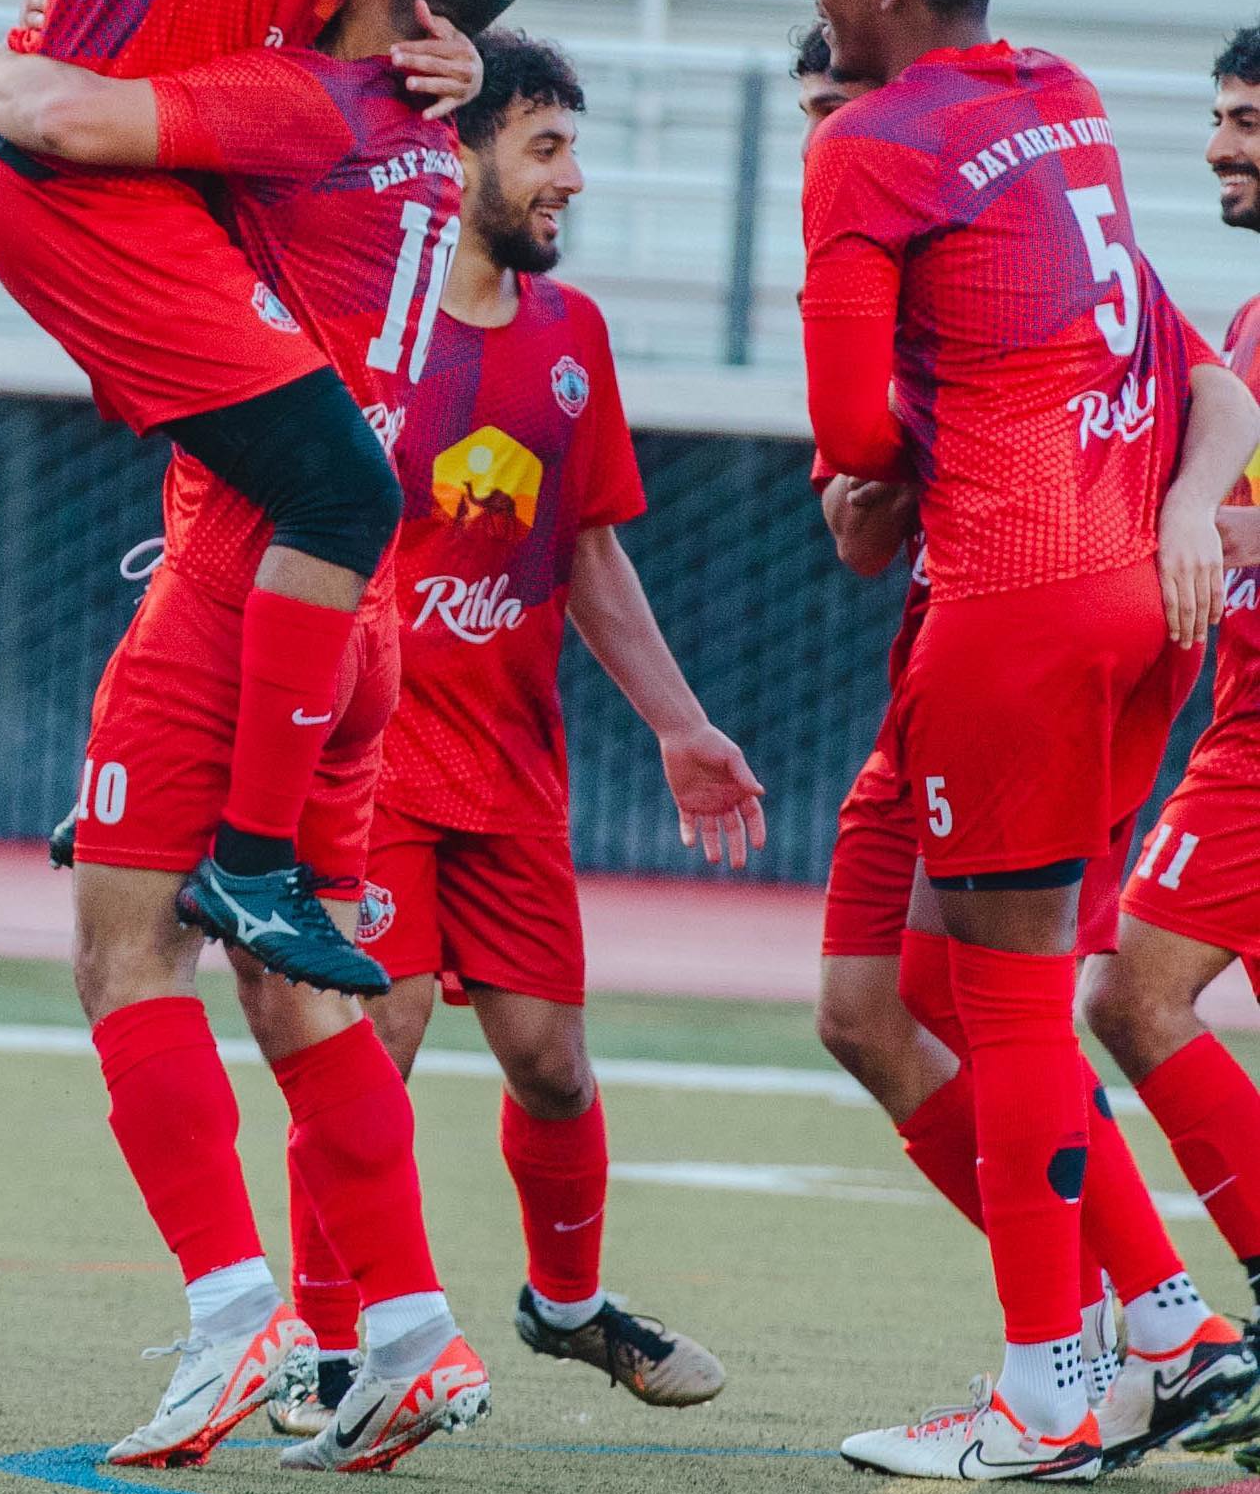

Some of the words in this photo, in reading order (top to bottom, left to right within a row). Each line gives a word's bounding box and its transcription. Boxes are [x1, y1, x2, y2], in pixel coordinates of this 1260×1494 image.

[369, 149, 419, 194] BAY
[958, 138, 1020, 190] BAY
[1013, 123, 1077, 160] AREA
[1070, 116, 1115, 146] UNIT
[1065, 184, 1140, 357] 5
[412, 573, 528, 645] Rihla
[78, 759, 128, 826] 10
[925, 775, 953, 839] 5
[1137, 823, 1200, 892] 11
